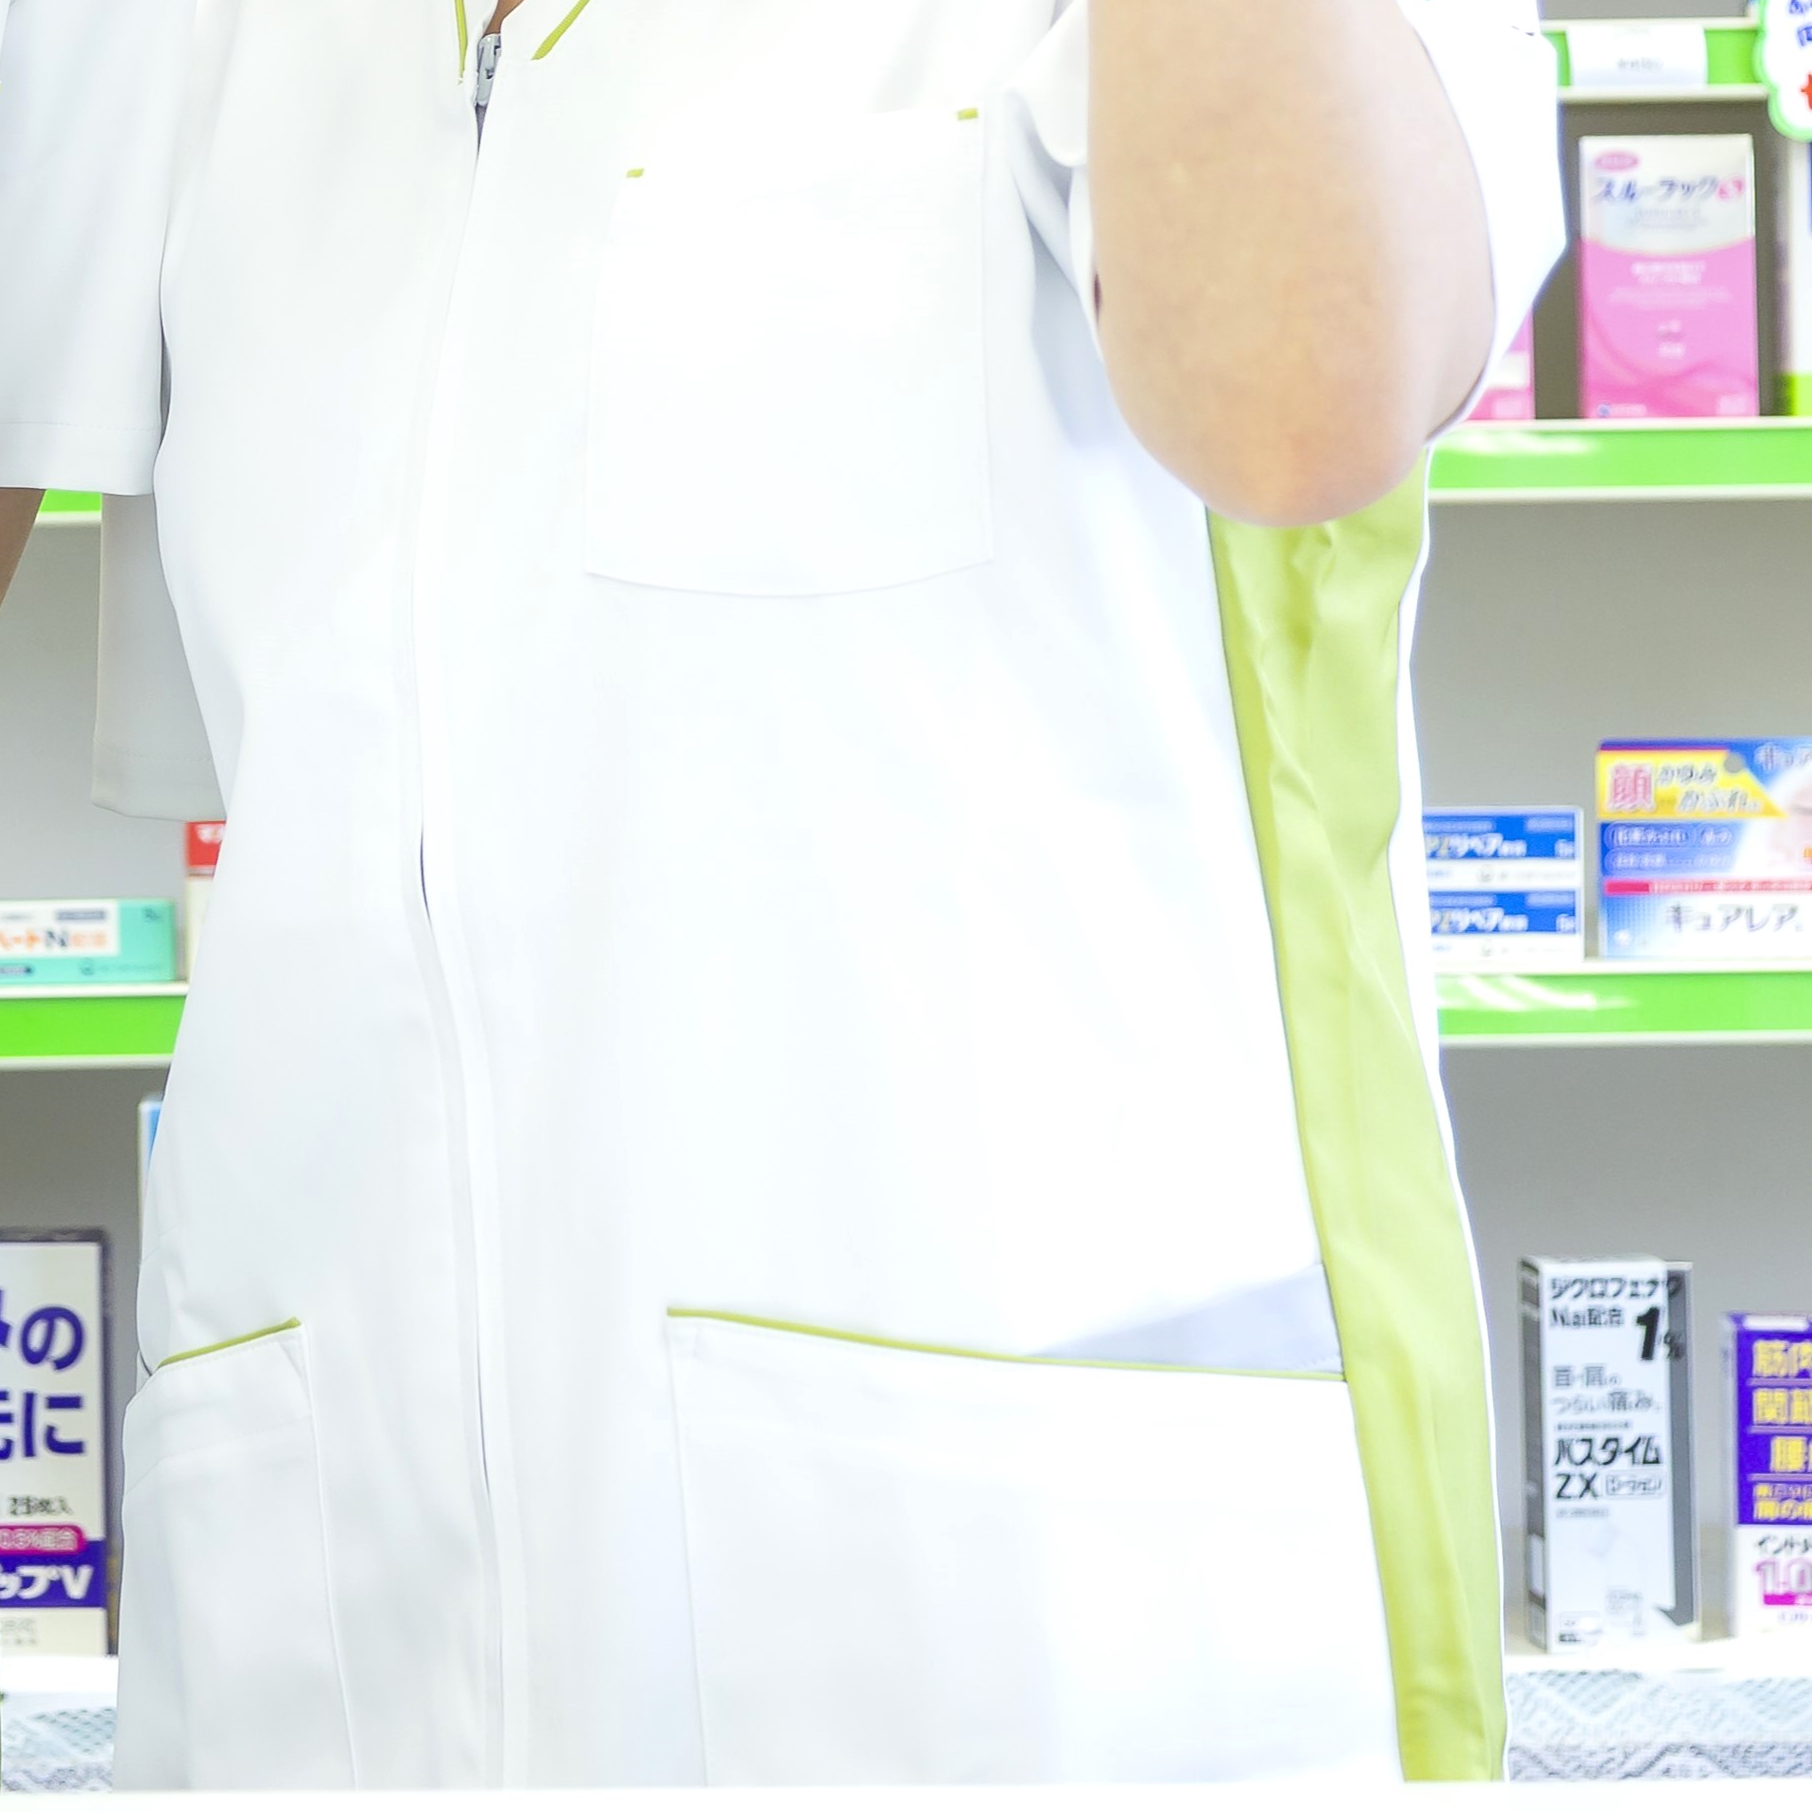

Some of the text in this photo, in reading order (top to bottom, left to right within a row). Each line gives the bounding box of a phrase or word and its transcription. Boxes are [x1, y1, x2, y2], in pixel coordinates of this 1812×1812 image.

[1609, 763, 1656, 811] 顔
[1550, 1275, 1681, 1301] ジクロフェナク
[1554, 1435, 1662, 1467] パスタイム
[1769, 1435, 1812, 1473] 腰
[1554, 1471, 1602, 1501] ZX
